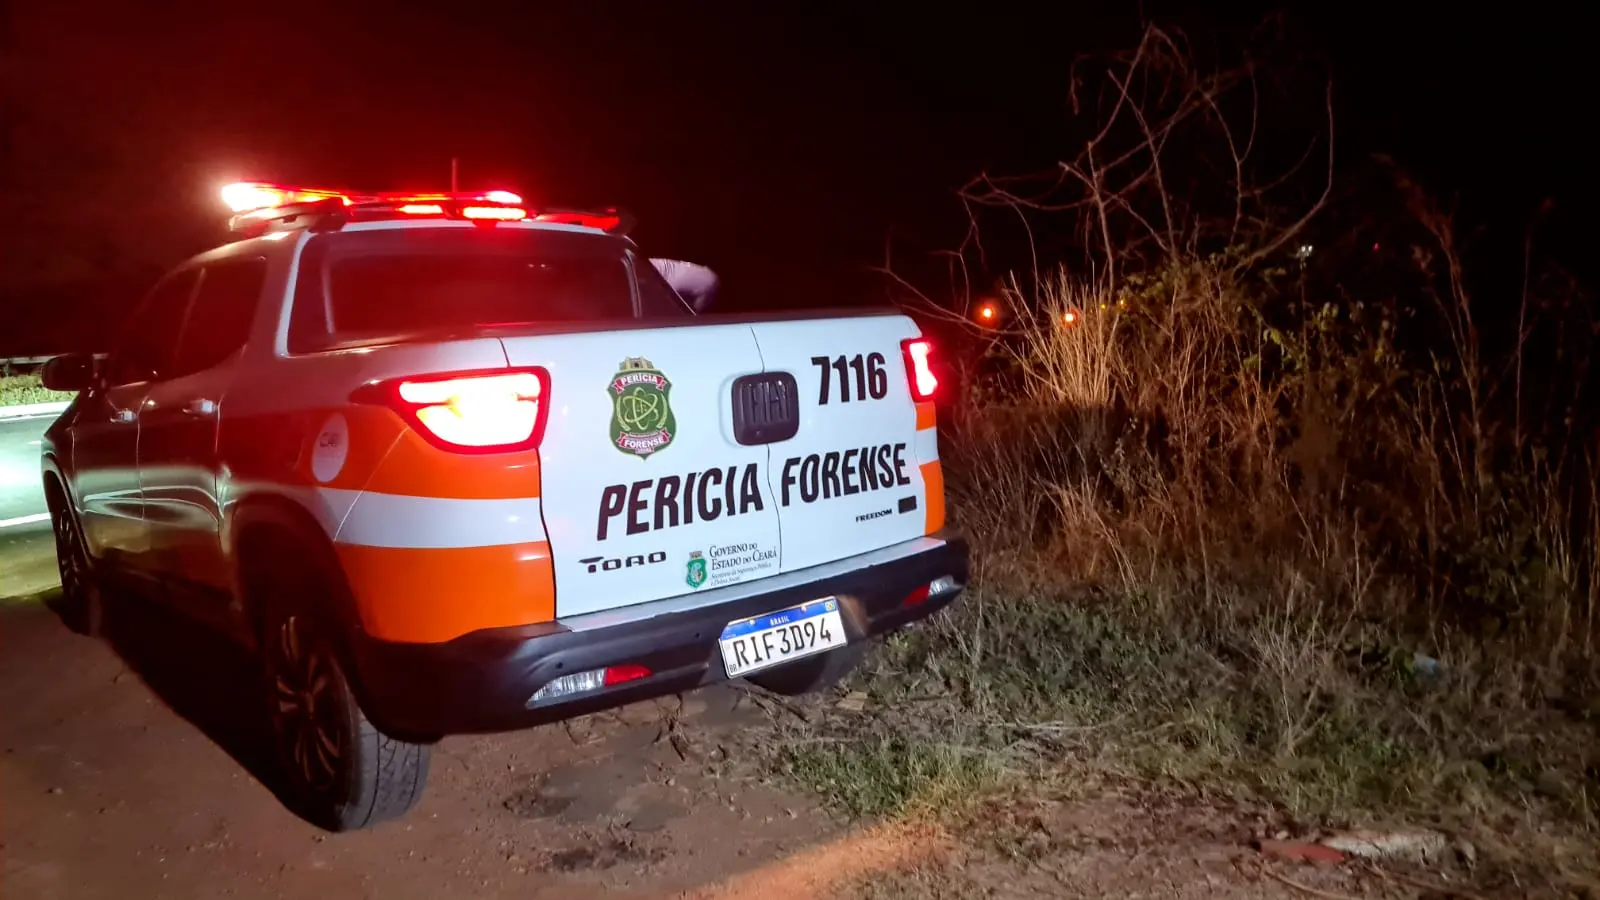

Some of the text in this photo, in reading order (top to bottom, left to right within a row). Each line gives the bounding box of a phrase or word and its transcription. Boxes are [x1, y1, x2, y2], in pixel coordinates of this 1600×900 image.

[811, 352, 888, 406] 7116
[624, 436, 665, 449] FORENSE
[781, 443, 911, 507] FORENSE
[855, 508, 893, 522] FREEDOM
[709, 543, 748, 558] GOVERNO
[578, 551, 667, 573] TORO
[711, 557, 741, 571] ESTADO
[732, 618, 832, 669] RIF3D94
